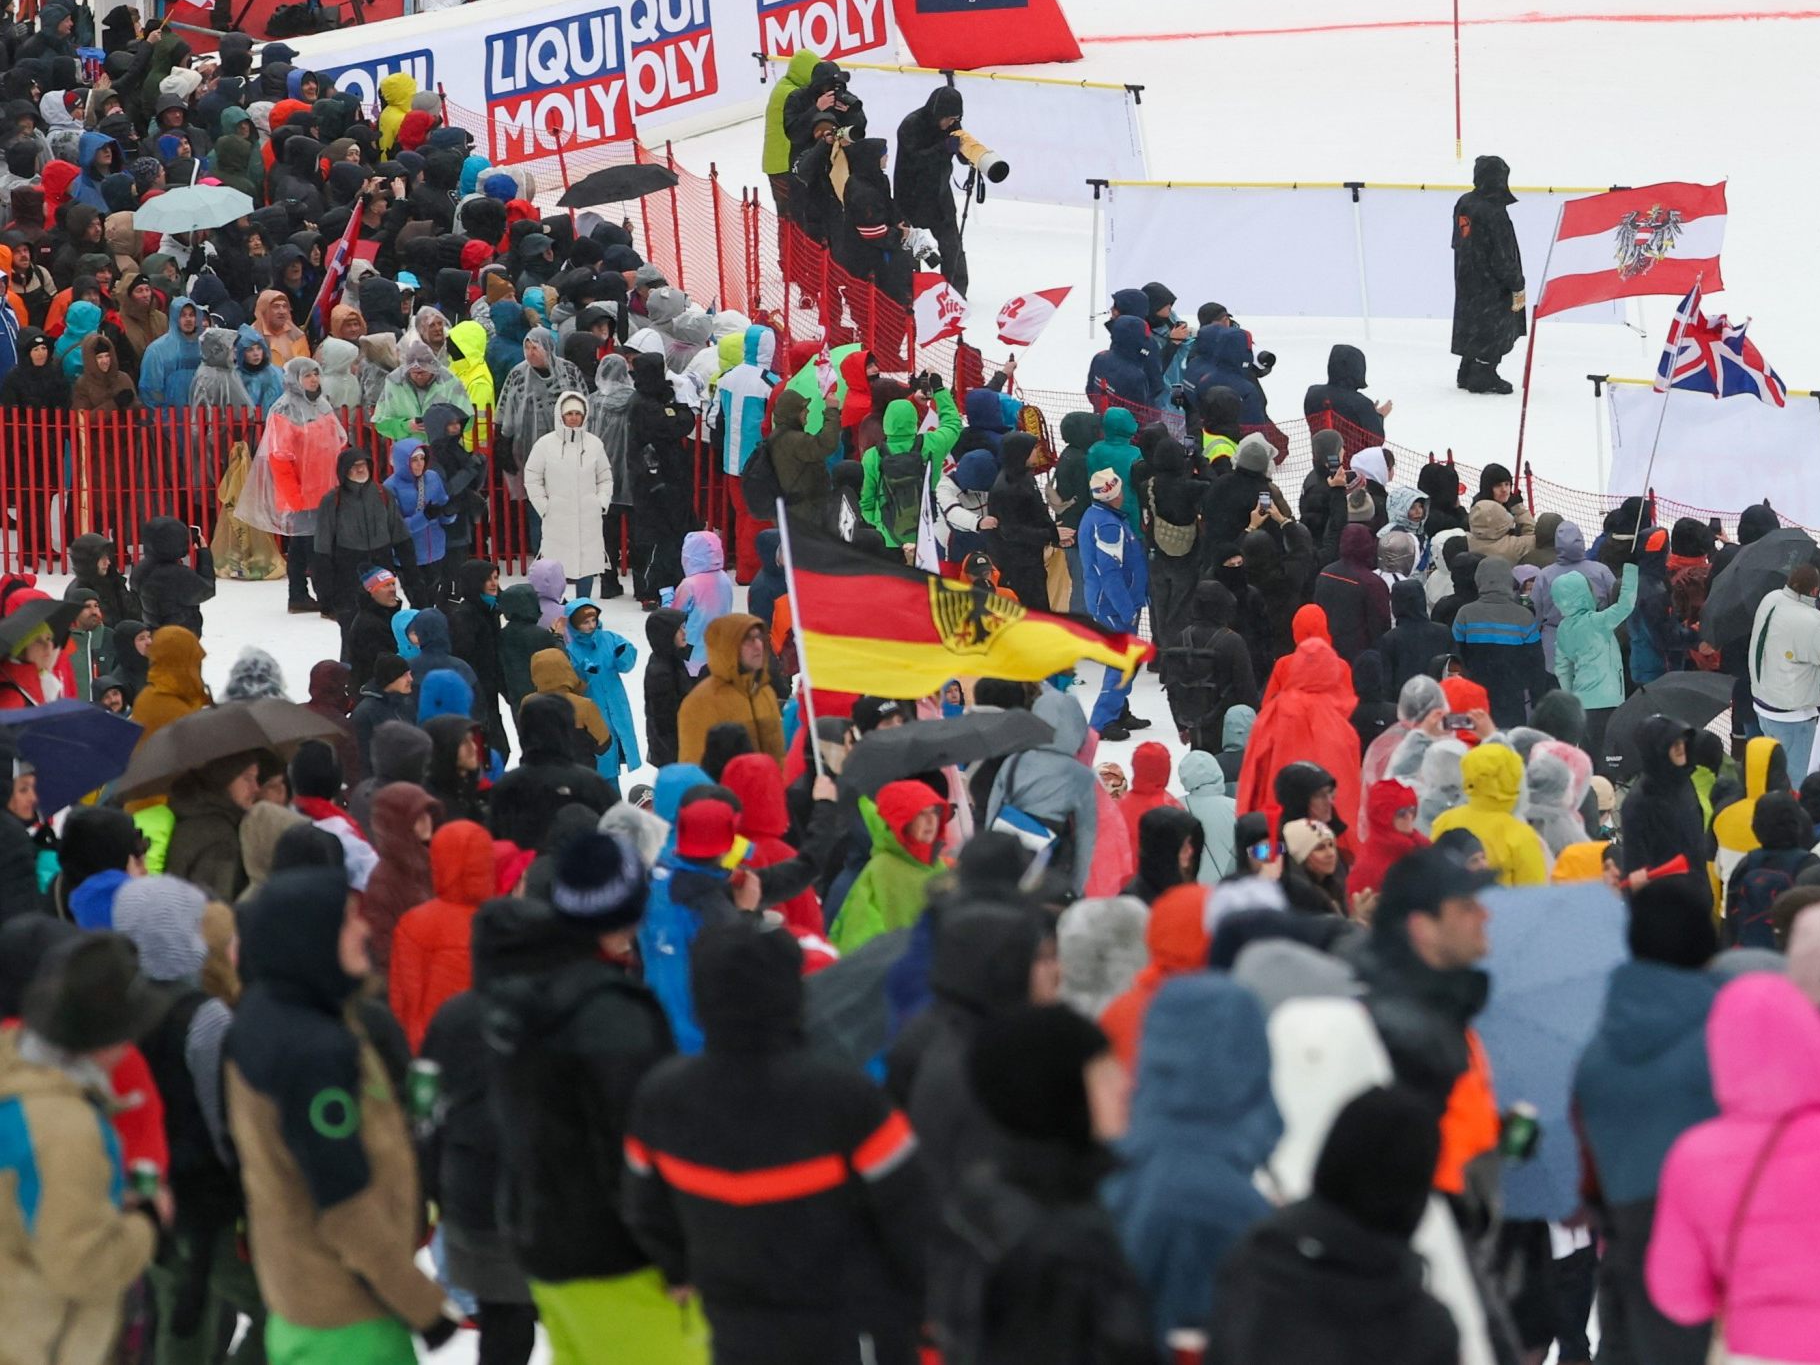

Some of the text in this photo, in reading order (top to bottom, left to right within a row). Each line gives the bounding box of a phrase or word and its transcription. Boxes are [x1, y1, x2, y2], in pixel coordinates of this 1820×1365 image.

[490, 12, 621, 95] LIQUI
[632, 34, 711, 109] OLY
[494, 79, 626, 163] MOLY
